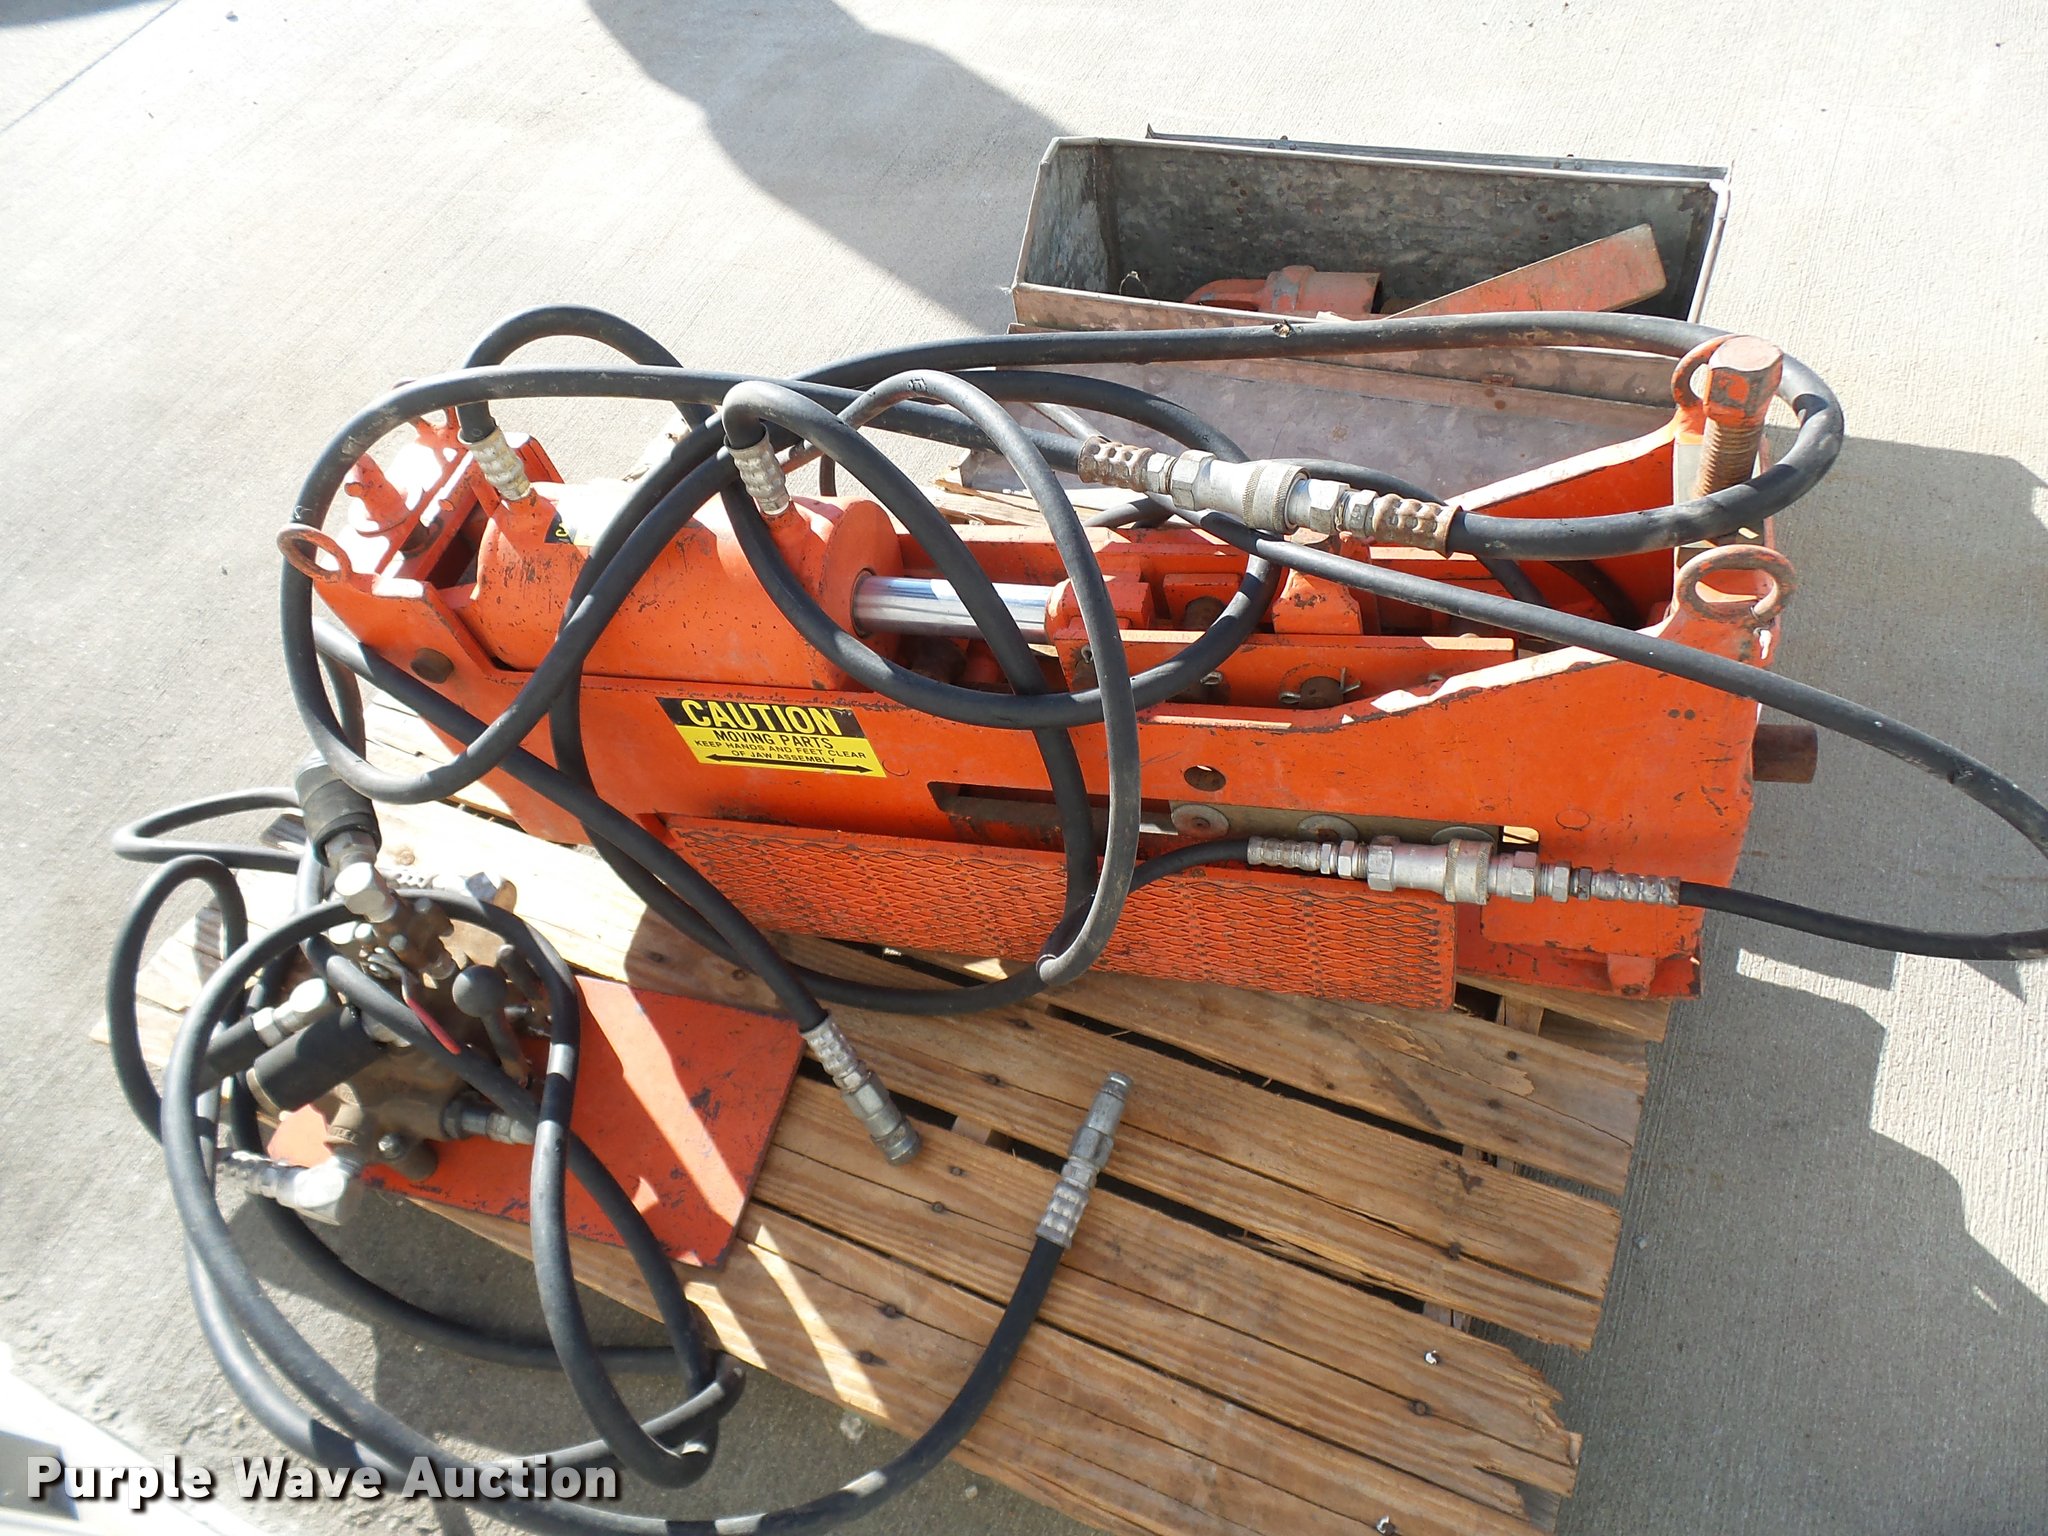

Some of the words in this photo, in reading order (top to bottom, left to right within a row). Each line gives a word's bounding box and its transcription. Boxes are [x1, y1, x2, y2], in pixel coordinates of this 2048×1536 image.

[681, 699, 843, 736] CAUTION
[712, 730, 775, 745] MOVING
[778, 734, 834, 749] PARTS
[694, 740, 722, 748] KEEP
[725, 743, 765, 751] HANDS
[796, 747, 823, 755] FEET
[827, 749, 867, 759] CLEAR
[777, 753, 835, 764] ASSEMBLY
